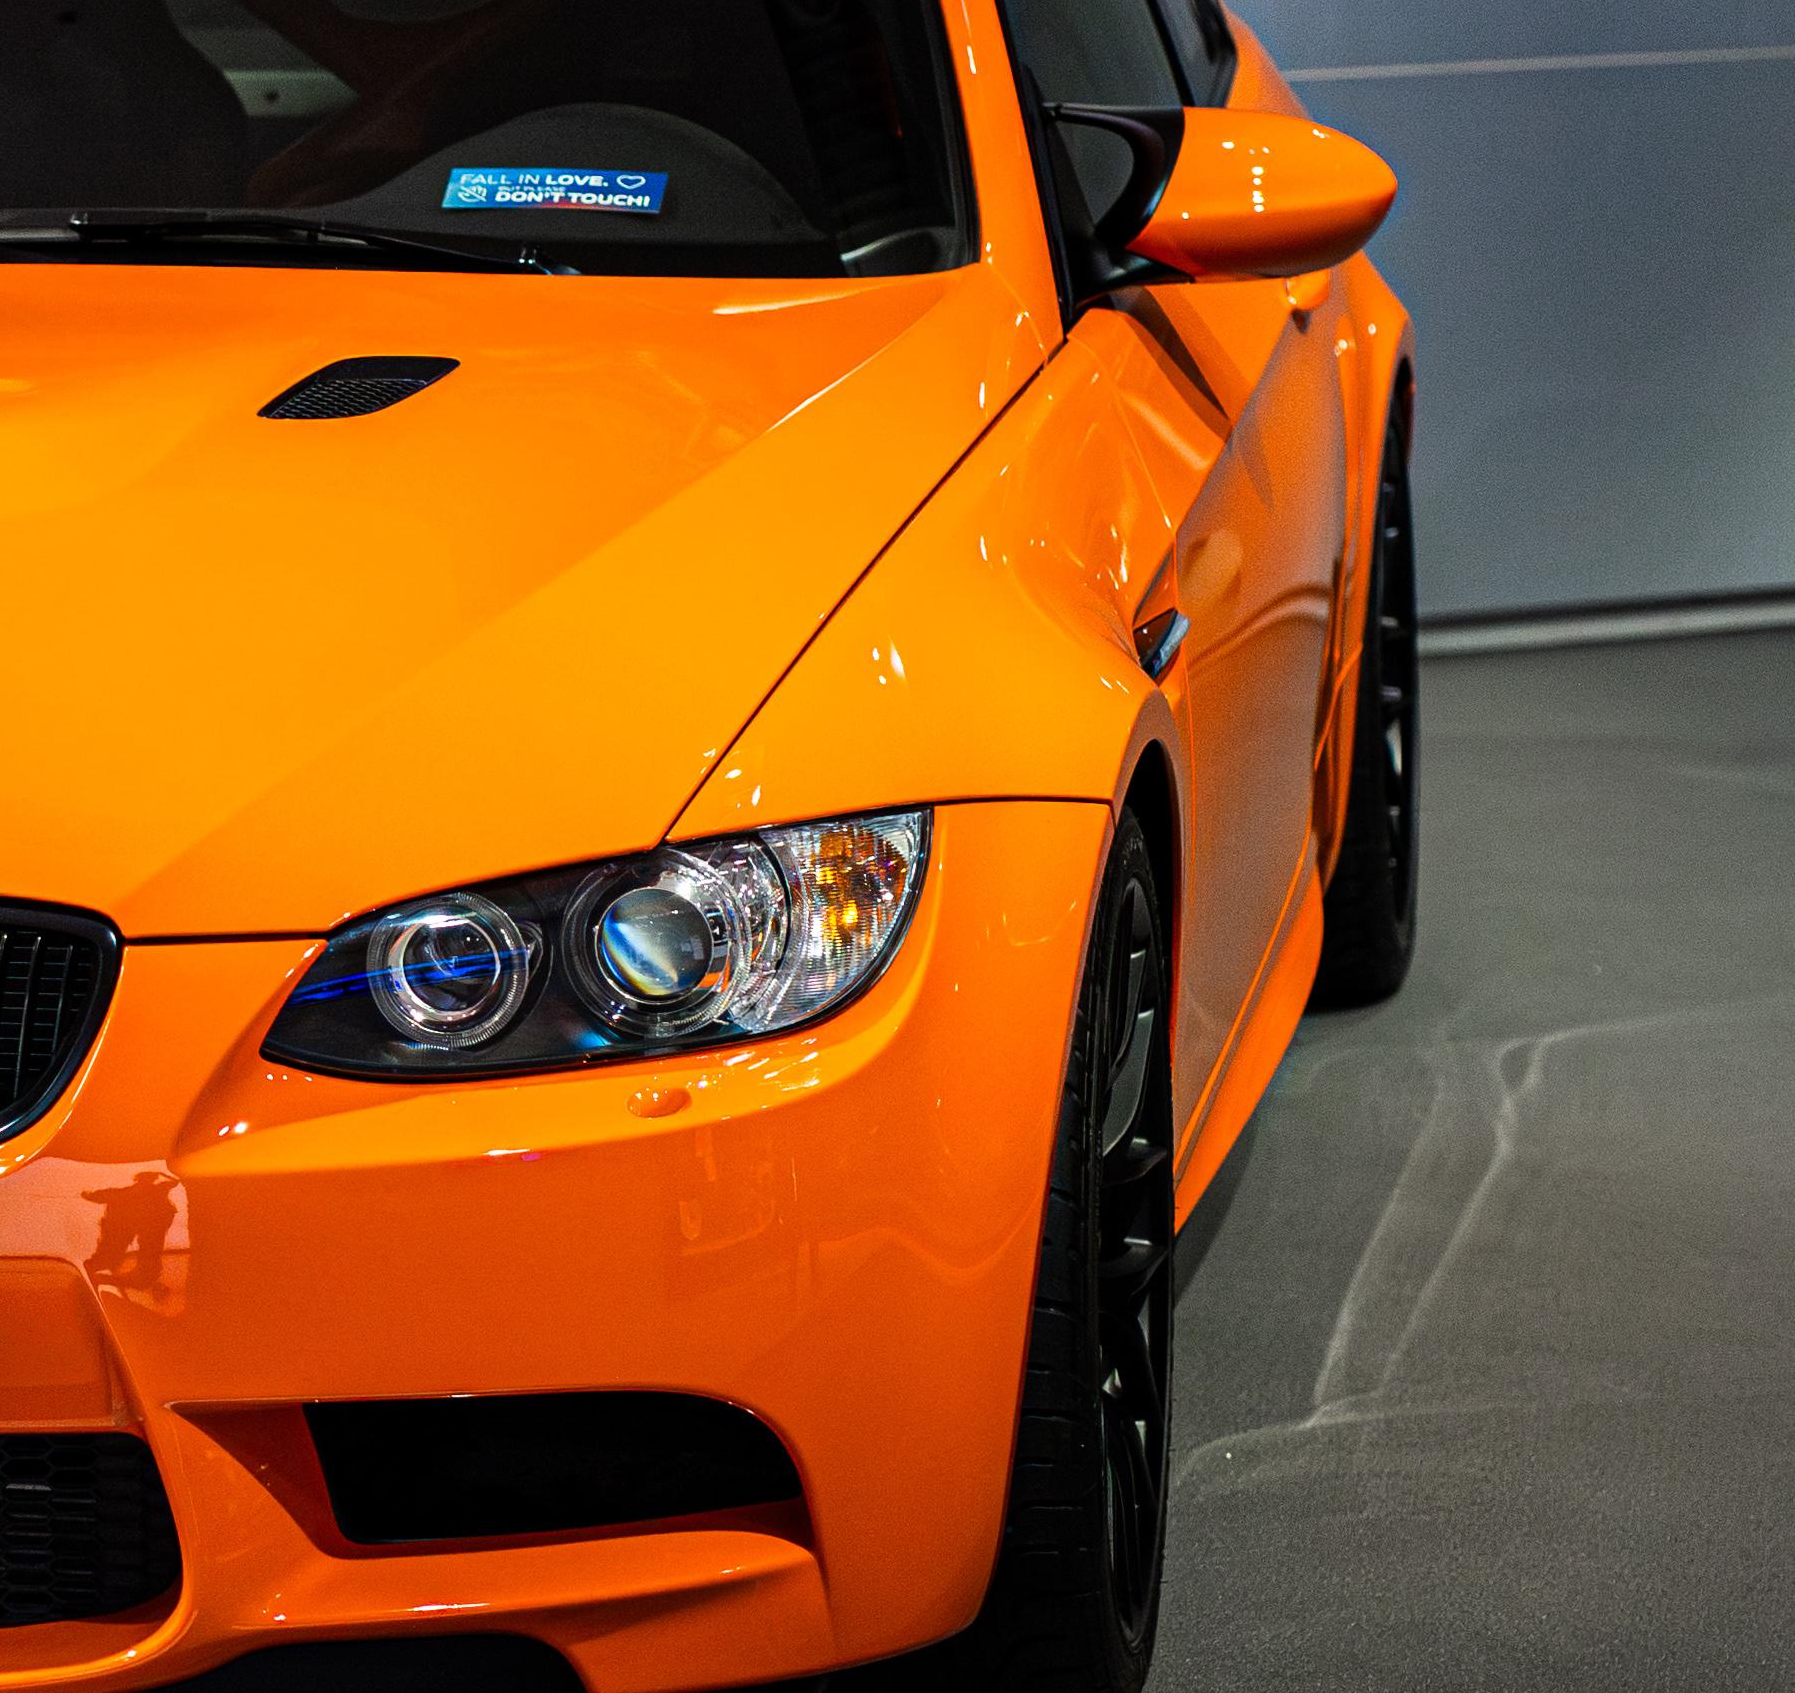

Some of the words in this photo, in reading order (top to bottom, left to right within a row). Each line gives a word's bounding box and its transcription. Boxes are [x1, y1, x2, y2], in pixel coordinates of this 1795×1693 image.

[460, 173, 513, 186] FALL
[519, 174, 540, 186] IN
[546, 174, 609, 187] LOVE.
[495, 191, 566, 204] DON'T
[568, 193, 651, 208] TOUCH!
